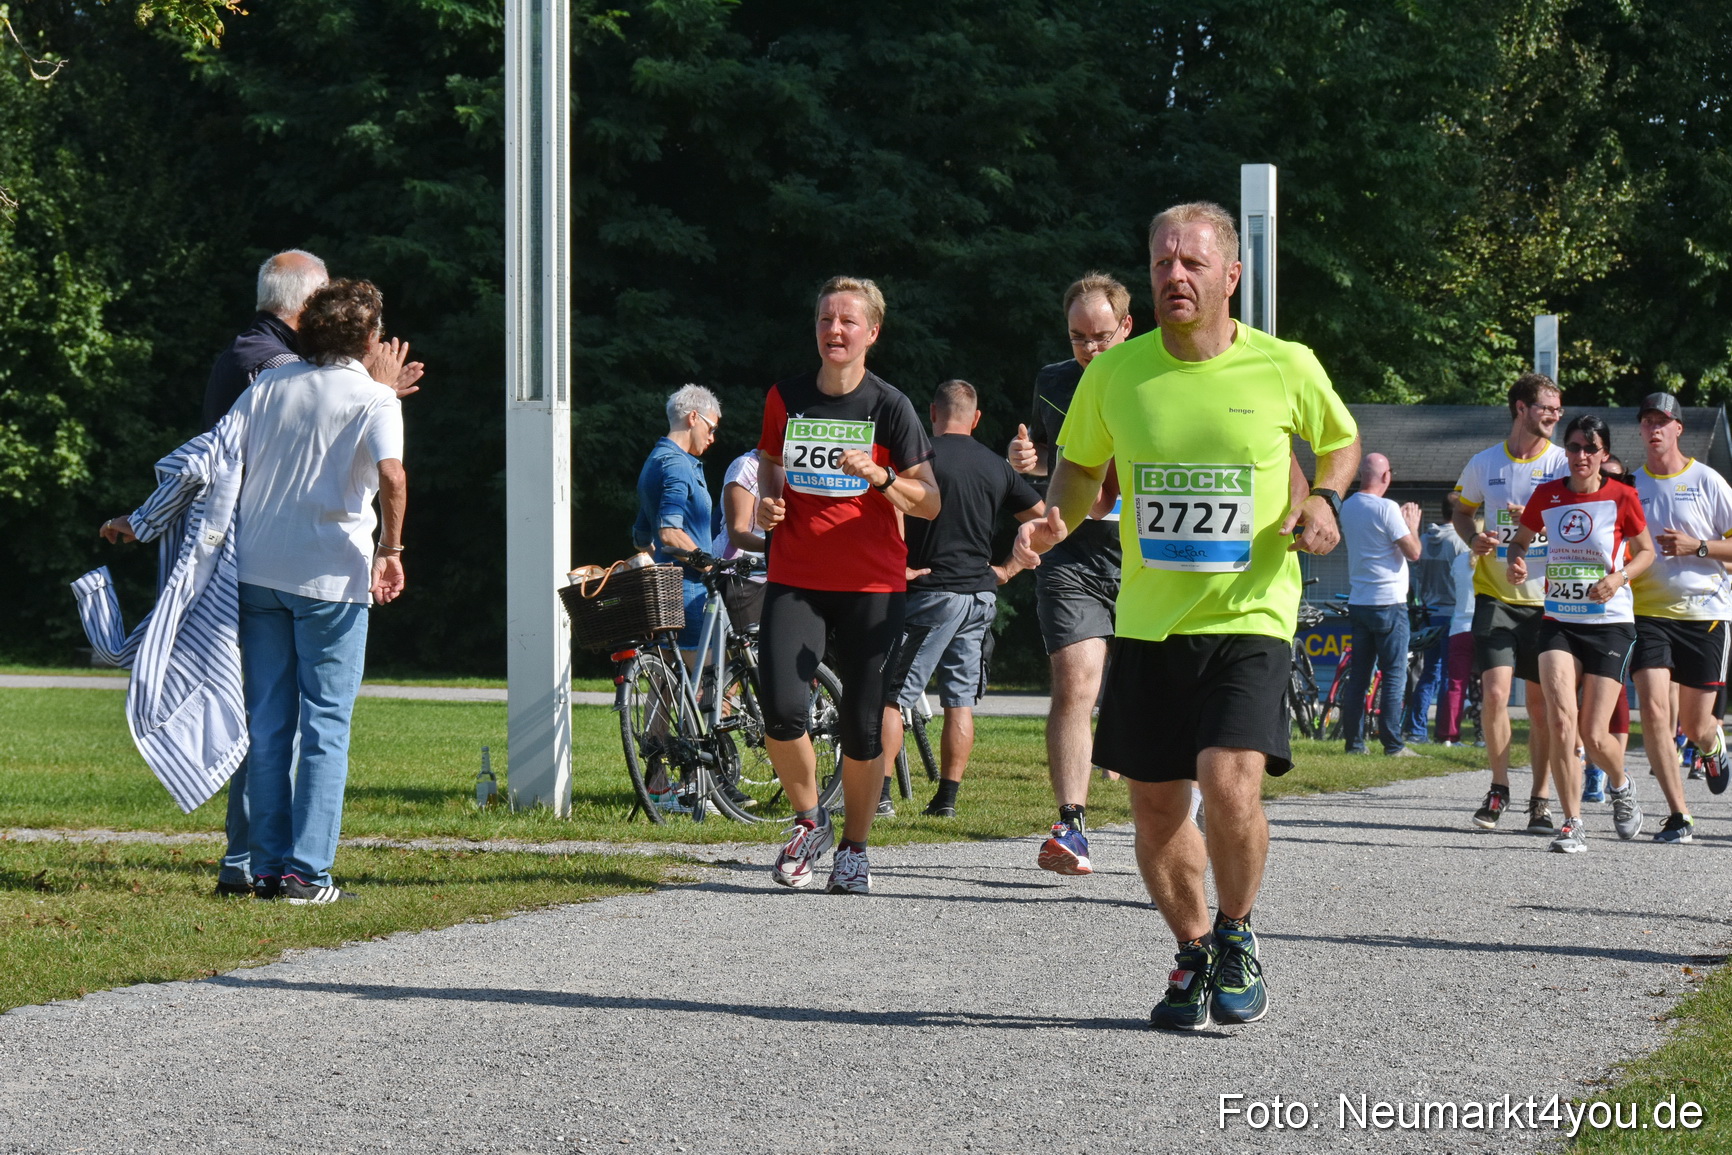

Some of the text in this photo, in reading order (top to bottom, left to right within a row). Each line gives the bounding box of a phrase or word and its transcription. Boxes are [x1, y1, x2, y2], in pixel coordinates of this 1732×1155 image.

[793, 422, 865, 441] BOCK
[793, 445, 844, 470] 266
[792, 474, 861, 488] ELISABETH
[1142, 468, 1243, 492] BOCK
[1147, 501, 1238, 534] 2727
[1161, 543, 1208, 562] Stefan
[1547, 564, 1600, 578] BOCK
[1557, 604, 1588, 613] DORIS
